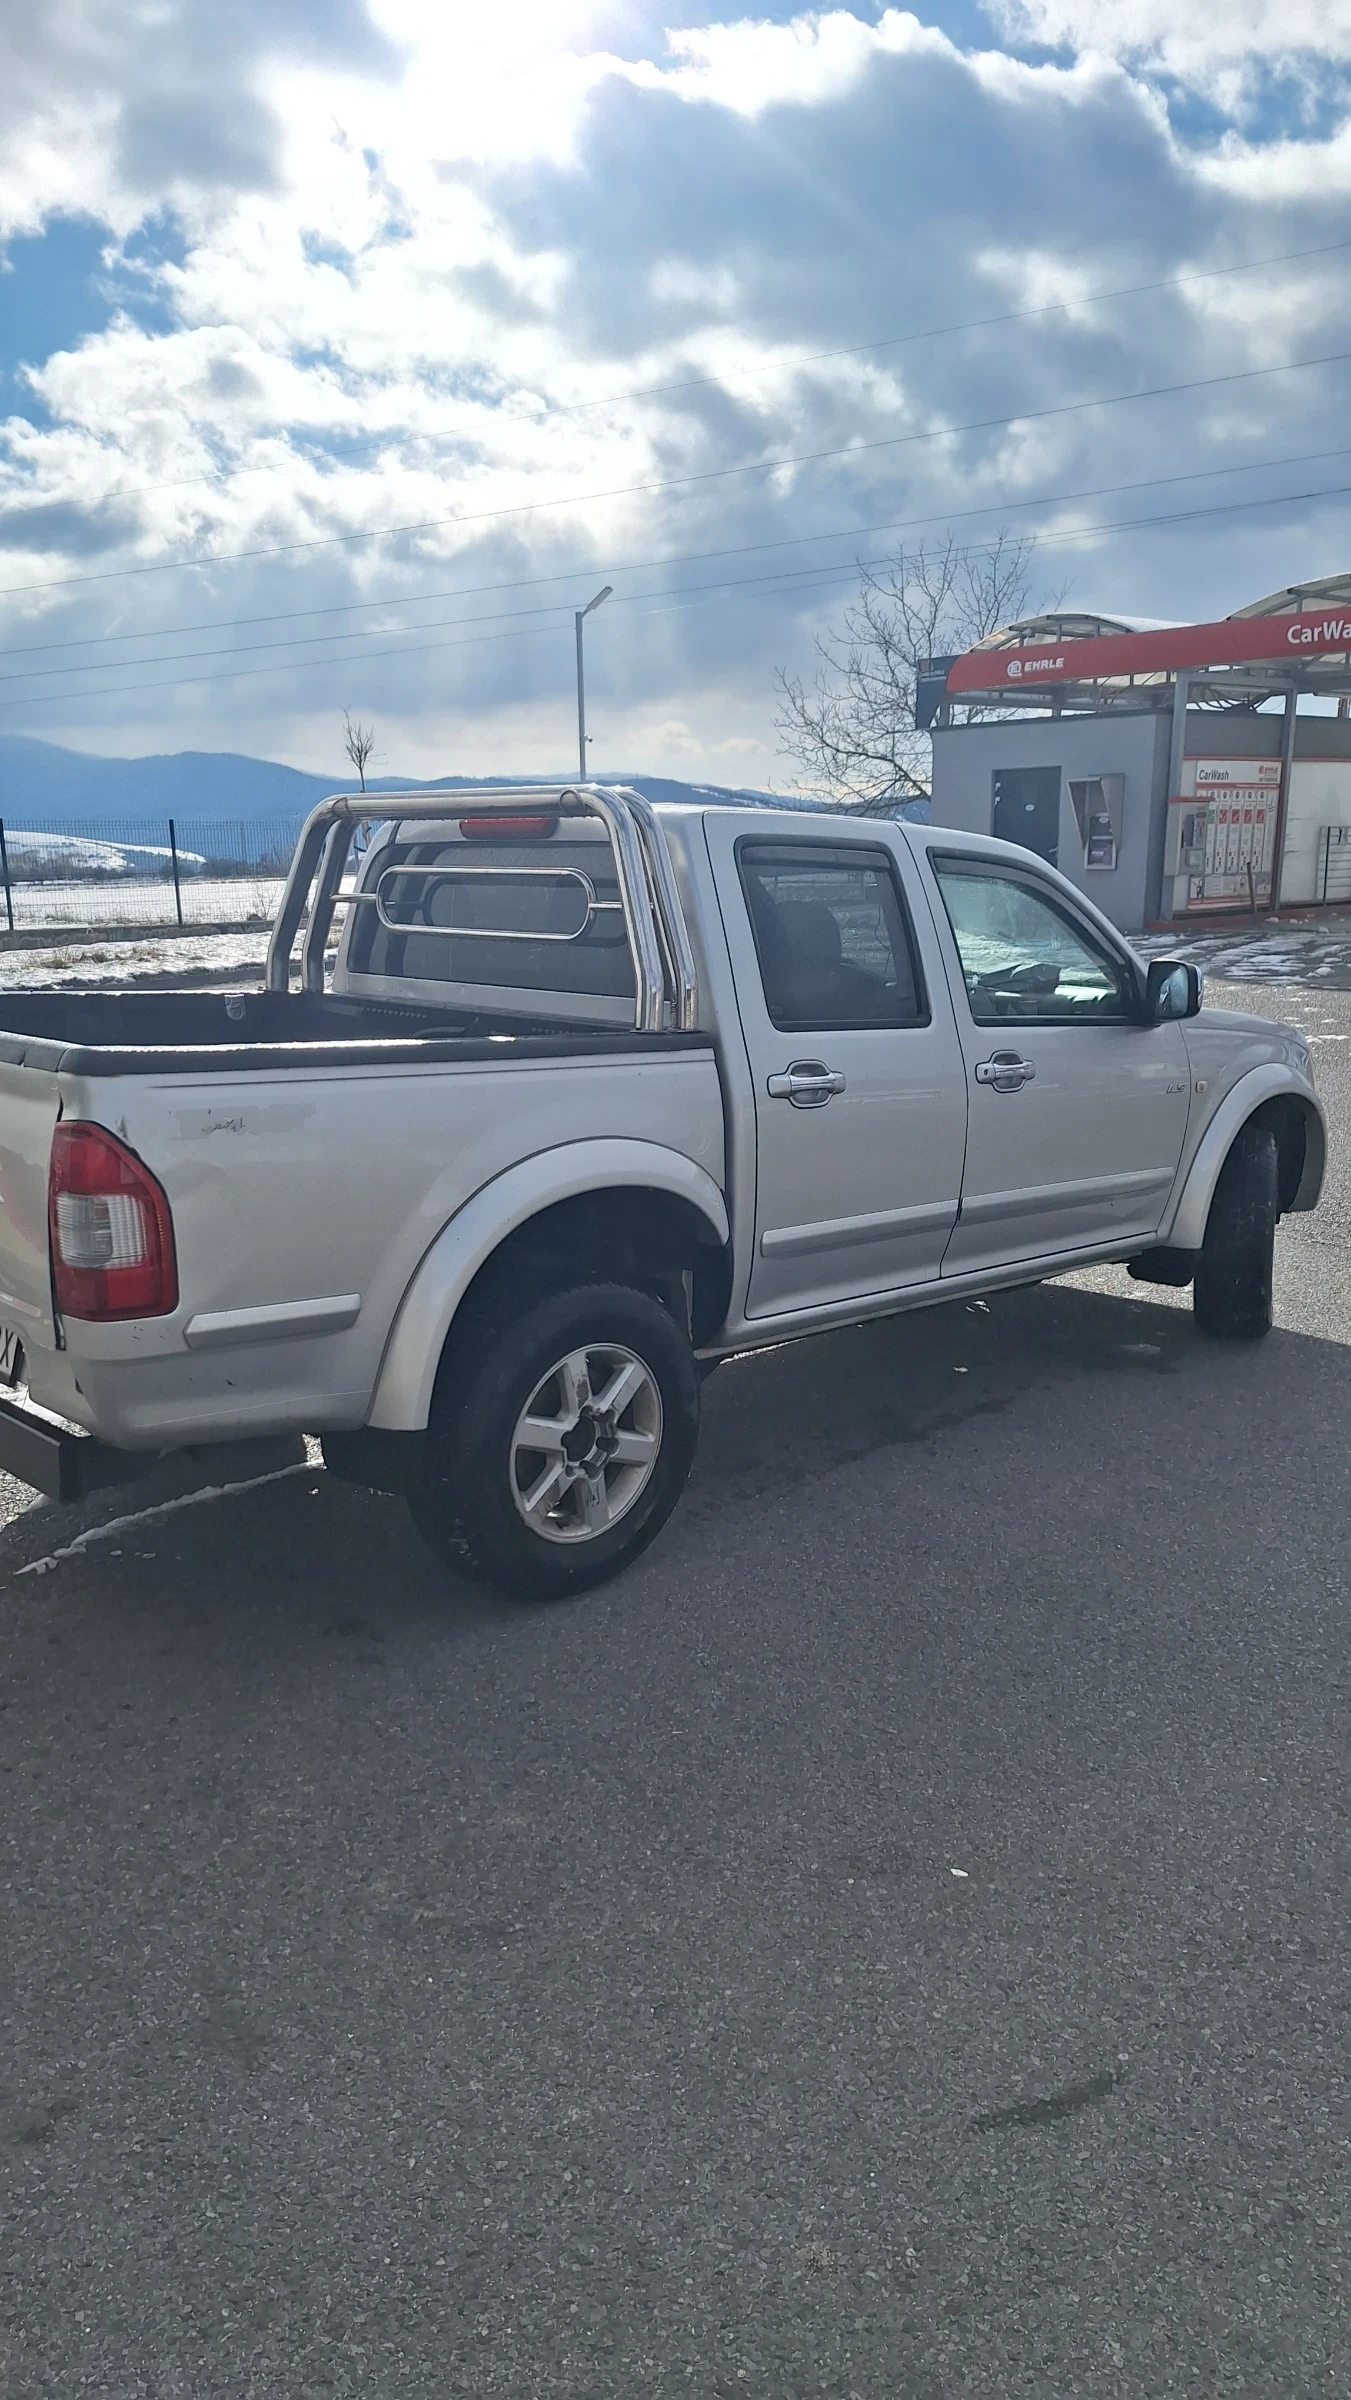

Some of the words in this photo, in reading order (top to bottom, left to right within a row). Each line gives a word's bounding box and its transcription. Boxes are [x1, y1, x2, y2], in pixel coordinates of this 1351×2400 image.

[1287, 620, 1351, 644] CarWa
[1024, 657, 1064, 672] EHRLE
[1199, 769, 1230, 780] CarWash
[0, 1325, 14, 1368] X
